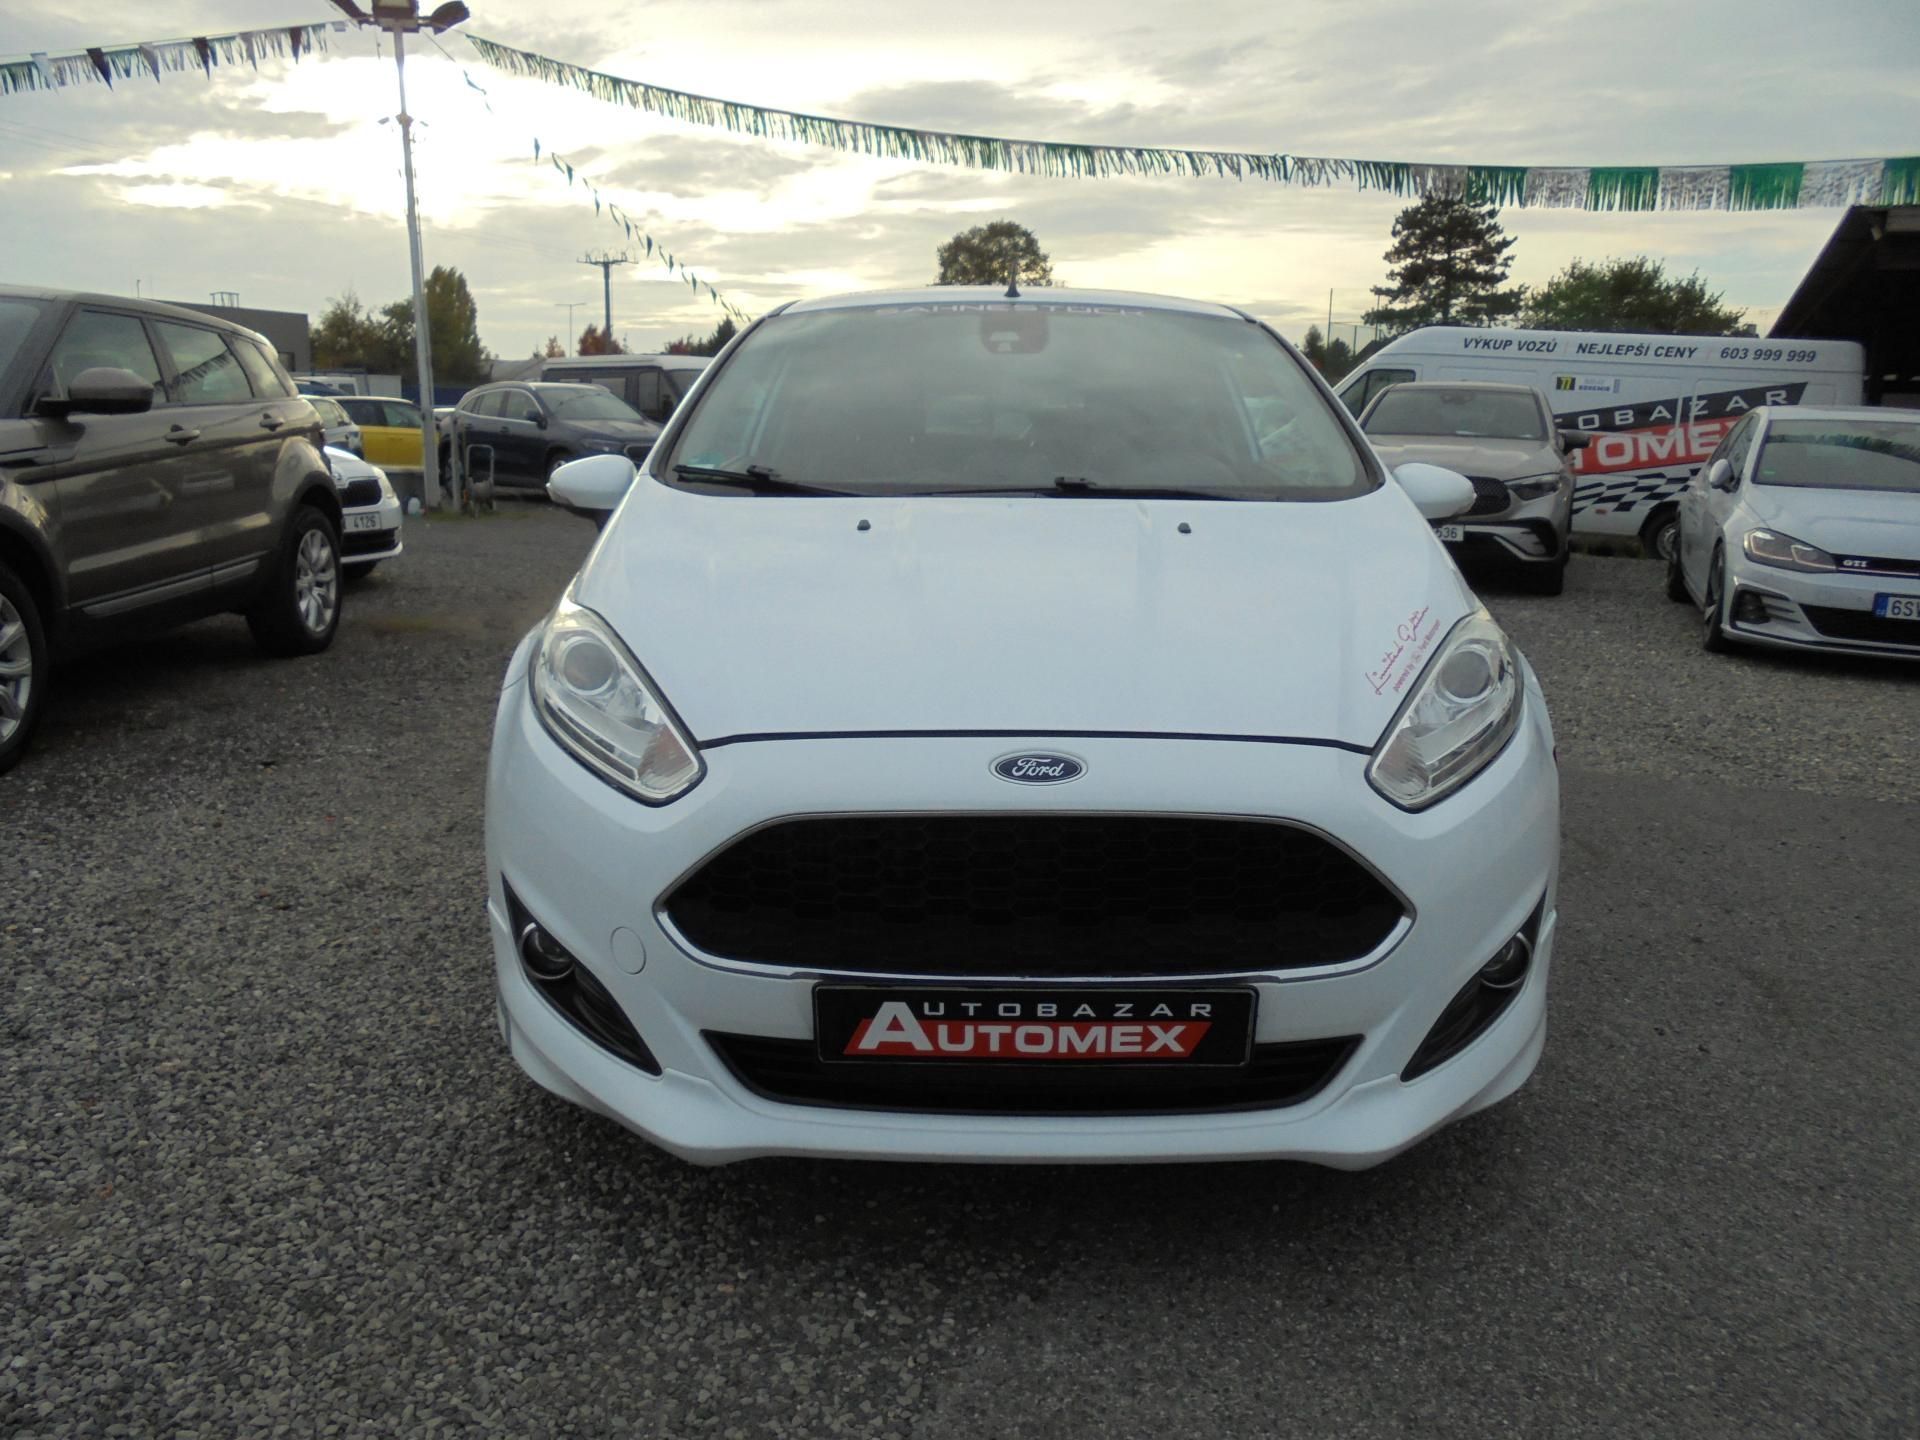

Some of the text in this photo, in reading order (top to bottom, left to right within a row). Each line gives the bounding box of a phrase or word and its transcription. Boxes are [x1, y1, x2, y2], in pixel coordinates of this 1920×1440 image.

[1463, 335, 1513, 351] VÝKUP
[1576, 341, 1699, 359] NEJLEPŠÍ CENY
[1720, 346, 1817, 363] 603 999 999
[1555, 388, 1788, 430] OBAZAR
[1843, 559, 1868, 568] GTI
[1011, 757, 1065, 777] Ford
[857, 1001, 1187, 1054] AUTOMEX
